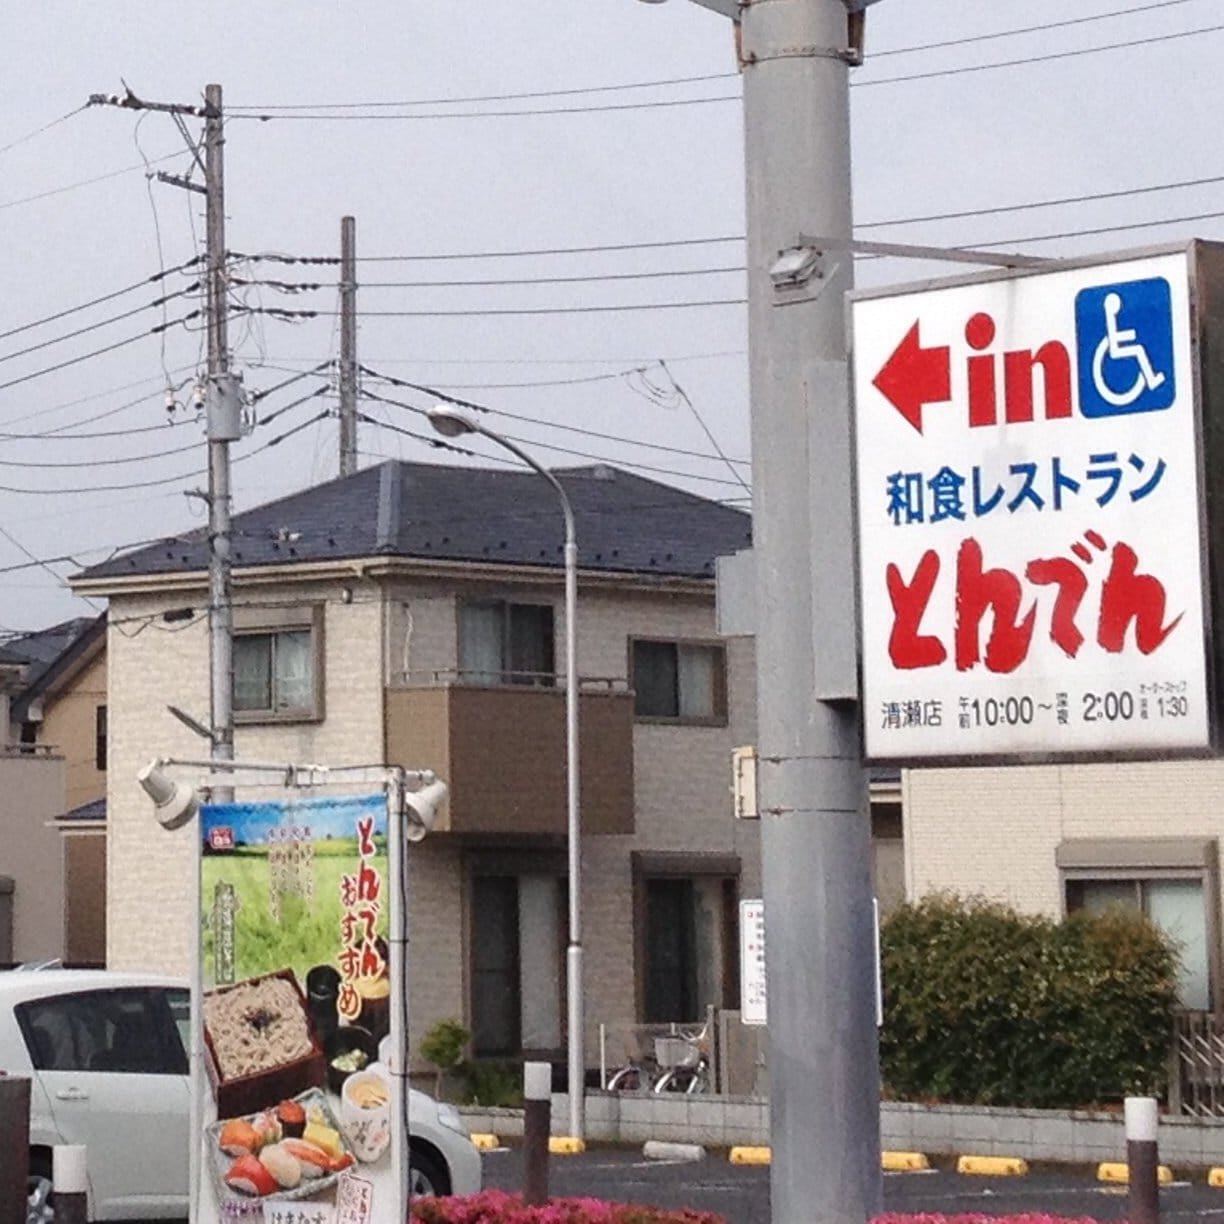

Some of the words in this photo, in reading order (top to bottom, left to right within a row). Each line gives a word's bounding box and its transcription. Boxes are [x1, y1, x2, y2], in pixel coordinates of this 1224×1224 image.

[964, 312, 1073, 429] in
[885, 452, 1168, 526] 和食レストラン
[885, 529, 1186, 675] とんでん
[881, 699, 942, 729] 清瀬店
[338, 875, 361, 1017] おすすめ
[358, 817, 383, 979] とんでん
